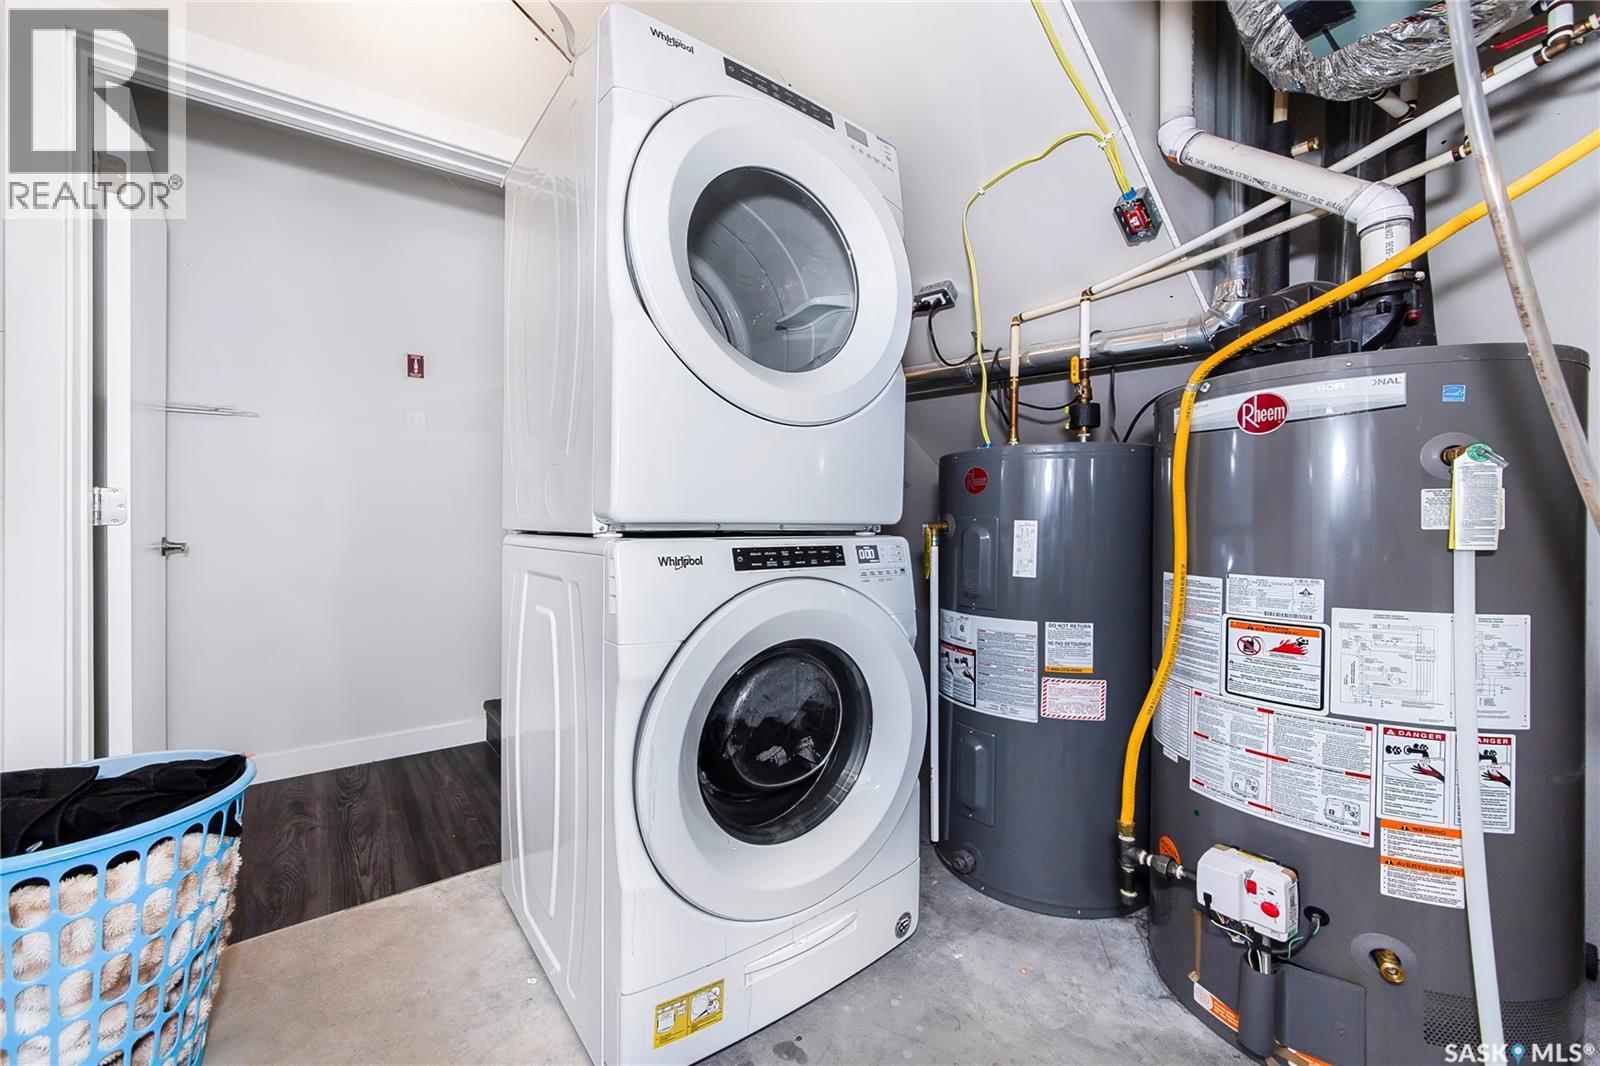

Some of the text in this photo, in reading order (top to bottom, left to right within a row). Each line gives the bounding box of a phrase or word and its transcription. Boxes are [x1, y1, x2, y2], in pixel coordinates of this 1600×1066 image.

[650, 26, 694, 54] Whirlpool
[1242, 395, 1285, 428] Rheem
[657, 555, 704, 570] Whirlpool
[1398, 730, 1442, 740] DANGER
[1412, 826, 1446, 836] WARNING
[1396, 861, 1460, 875] AVERTISSEMENT
